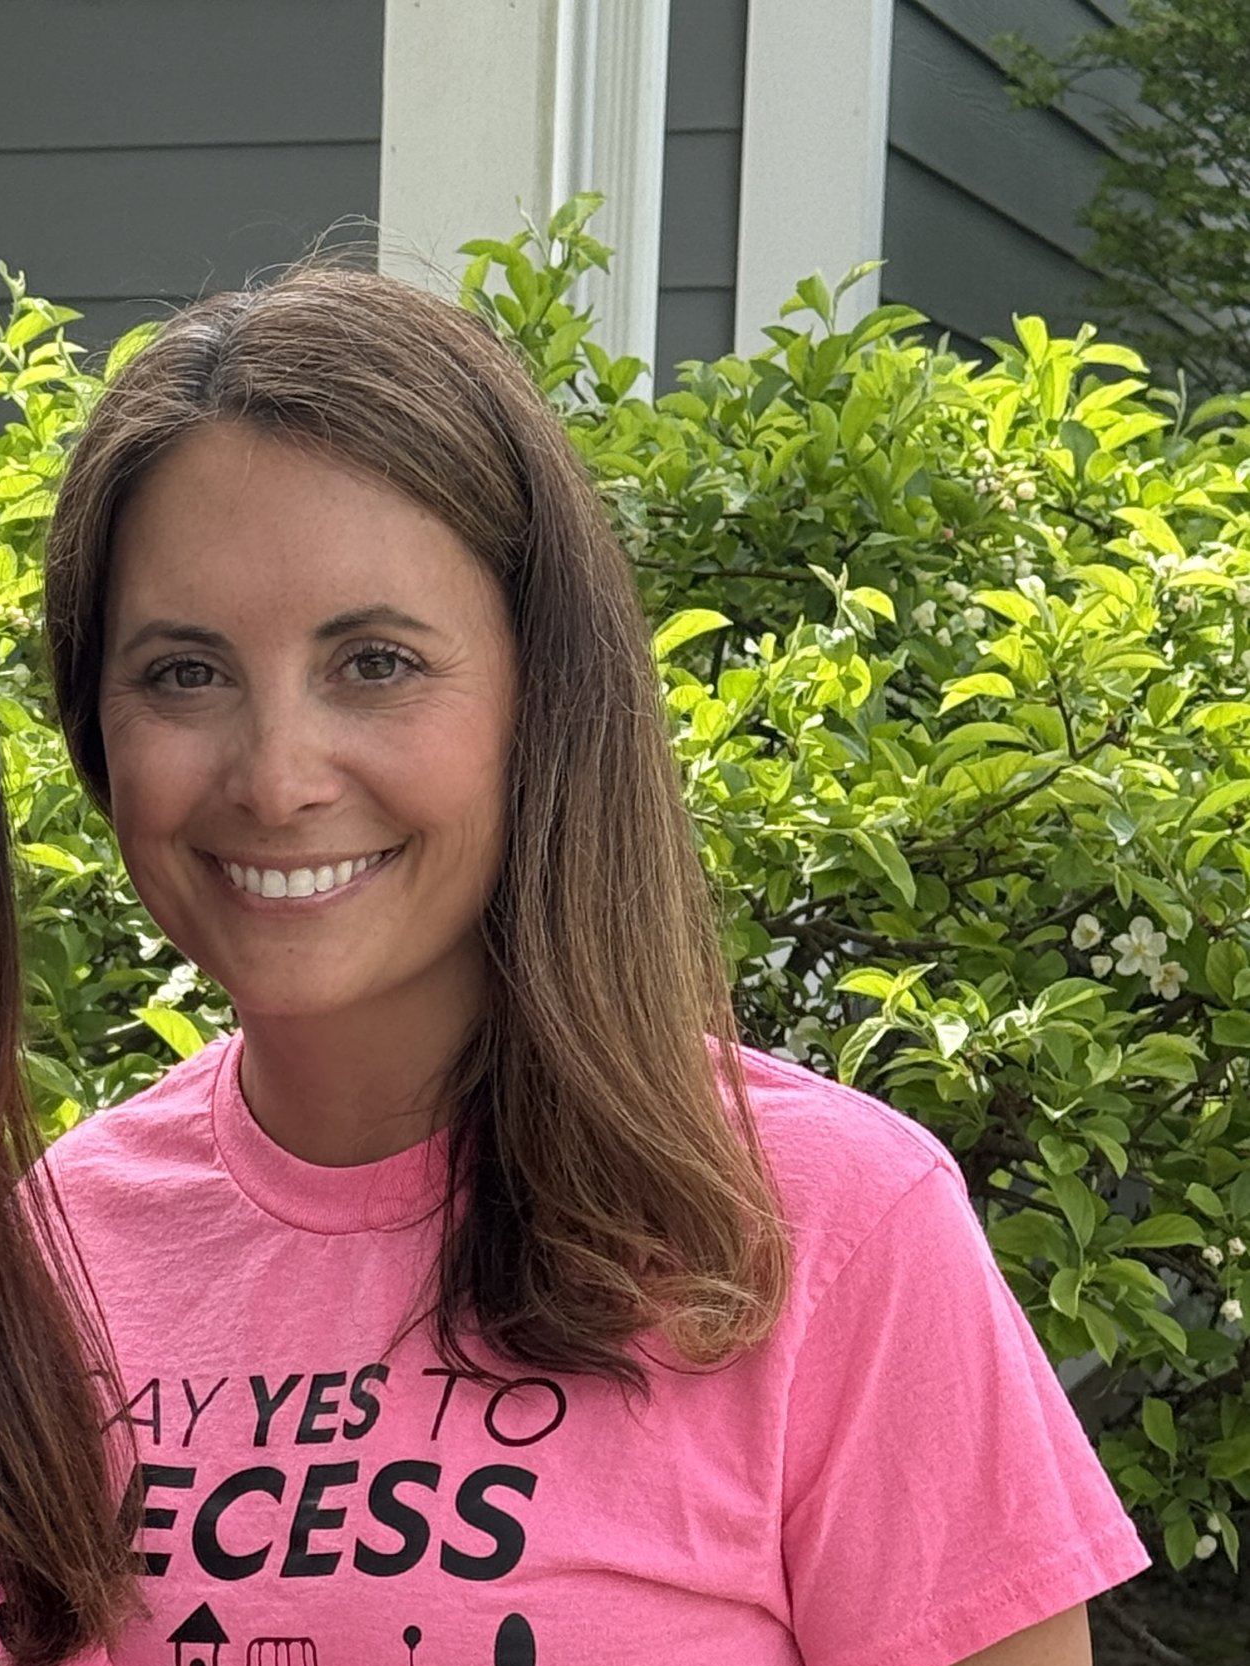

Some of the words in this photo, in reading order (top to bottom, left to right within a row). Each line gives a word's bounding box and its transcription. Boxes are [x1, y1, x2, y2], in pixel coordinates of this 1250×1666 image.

[86, 1369, 229, 1448] AY
[249, 1363, 391, 1447] YES
[422, 1367, 567, 1447] TO
[110, 1459, 538, 1581] ECESS
